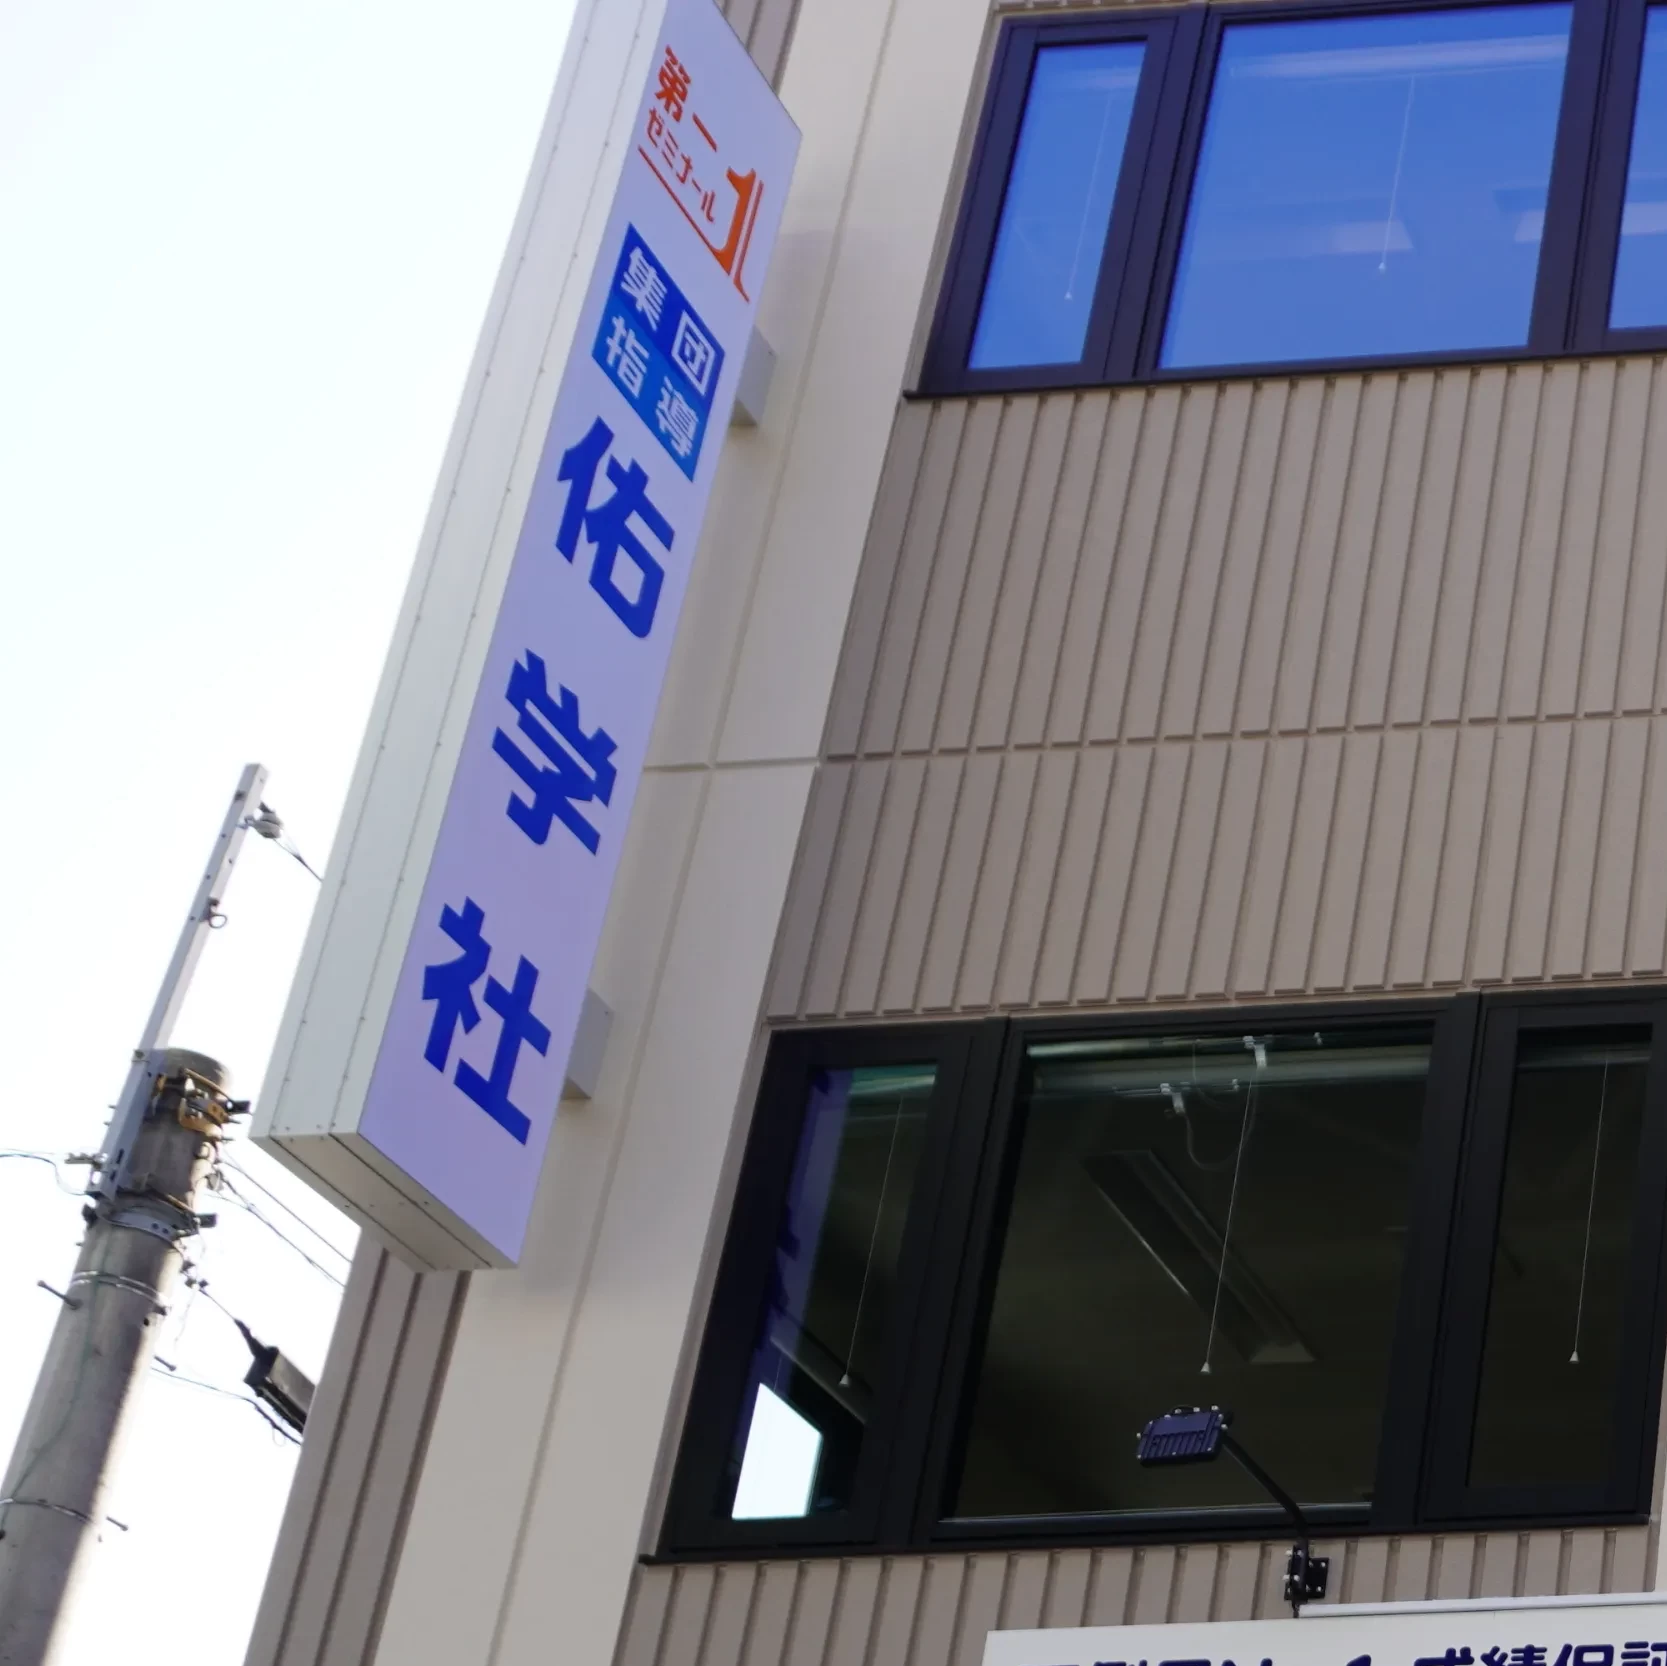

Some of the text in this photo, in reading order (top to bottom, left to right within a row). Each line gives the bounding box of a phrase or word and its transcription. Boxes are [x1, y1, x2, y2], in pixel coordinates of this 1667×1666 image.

[646, 105, 715, 224] ゼミナール
[655, 45, 718, 152] 第一
[606, 315, 699, 458] 指導
[621, 246, 716, 397] 集団
[423, 415, 676, 1146] 佑学社
